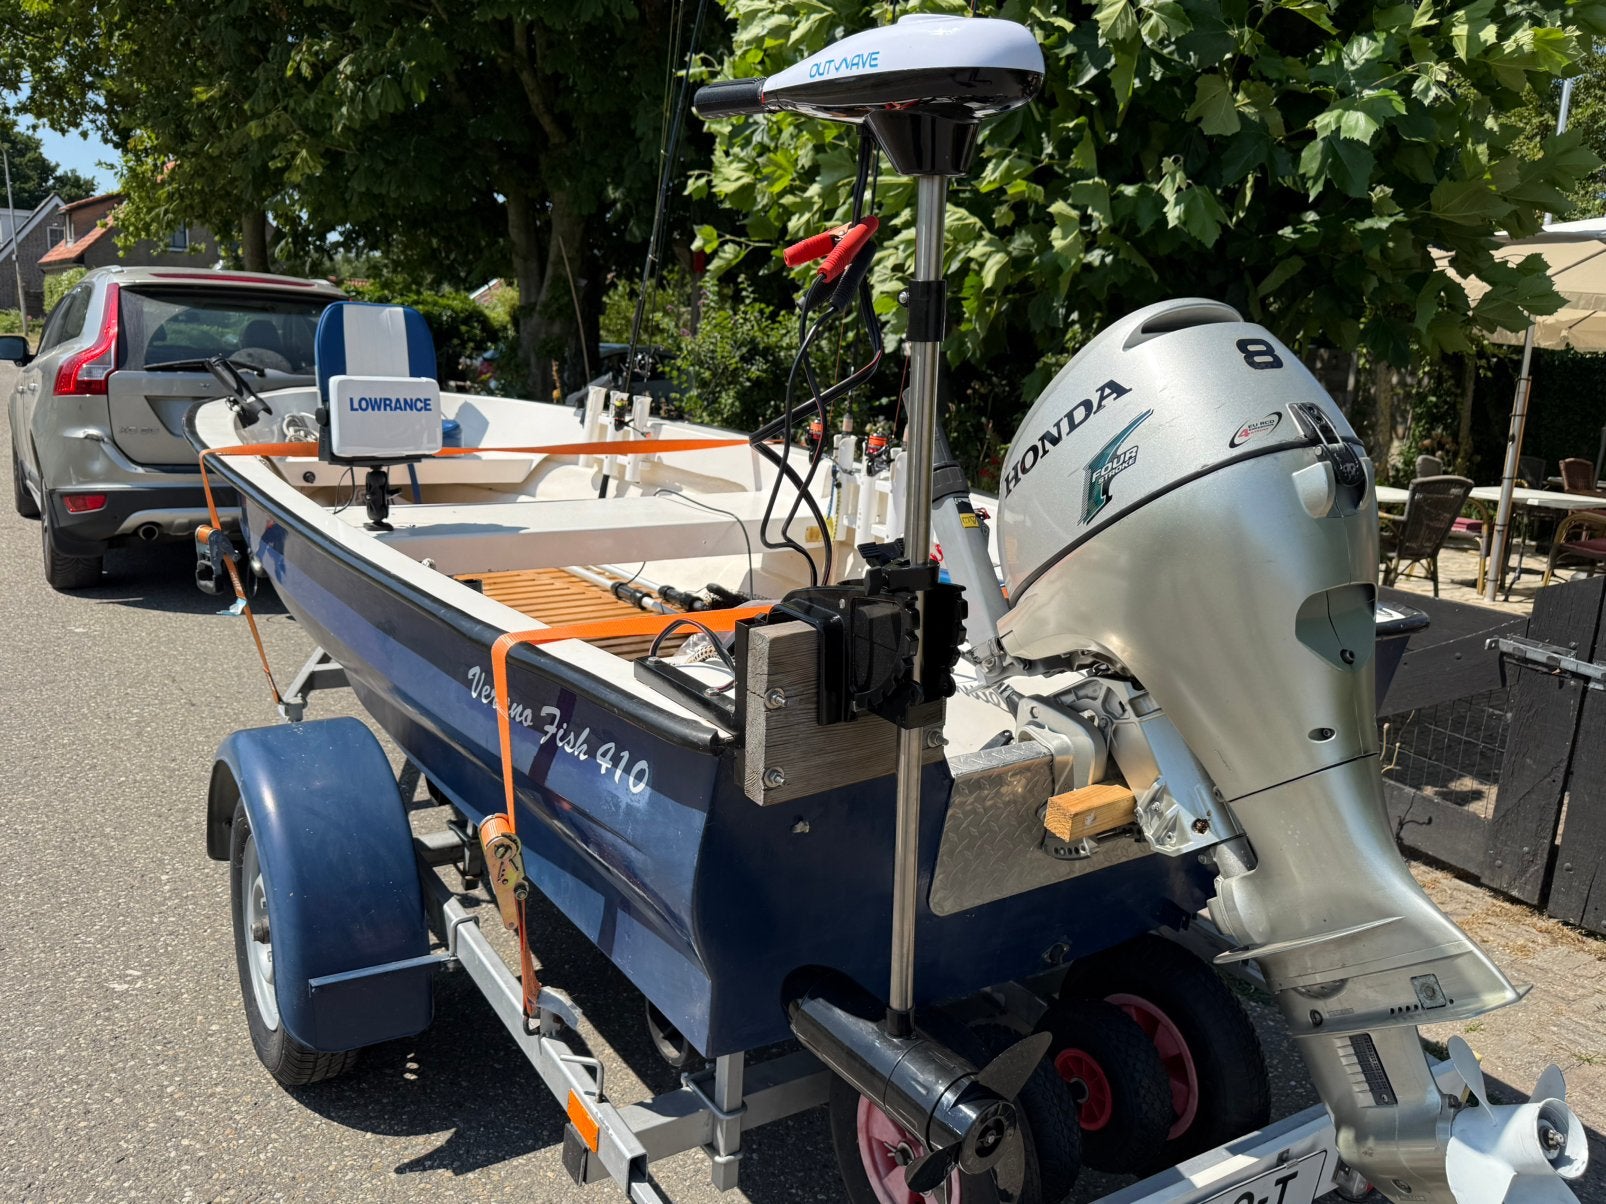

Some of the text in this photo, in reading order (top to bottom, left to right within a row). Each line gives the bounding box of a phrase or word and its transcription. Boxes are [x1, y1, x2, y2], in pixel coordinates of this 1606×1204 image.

[809, 51, 880, 79] OUTWAVE
[1236, 338, 1284, 370] 8
[349, 397, 432, 412] LOWRANCE
[1004, 379, 1132, 499] HONDA
[1092, 446, 1137, 482] FOUR
[1097, 457, 1136, 485] STROKE
[467, 665, 649, 794] Verno Fish 410
